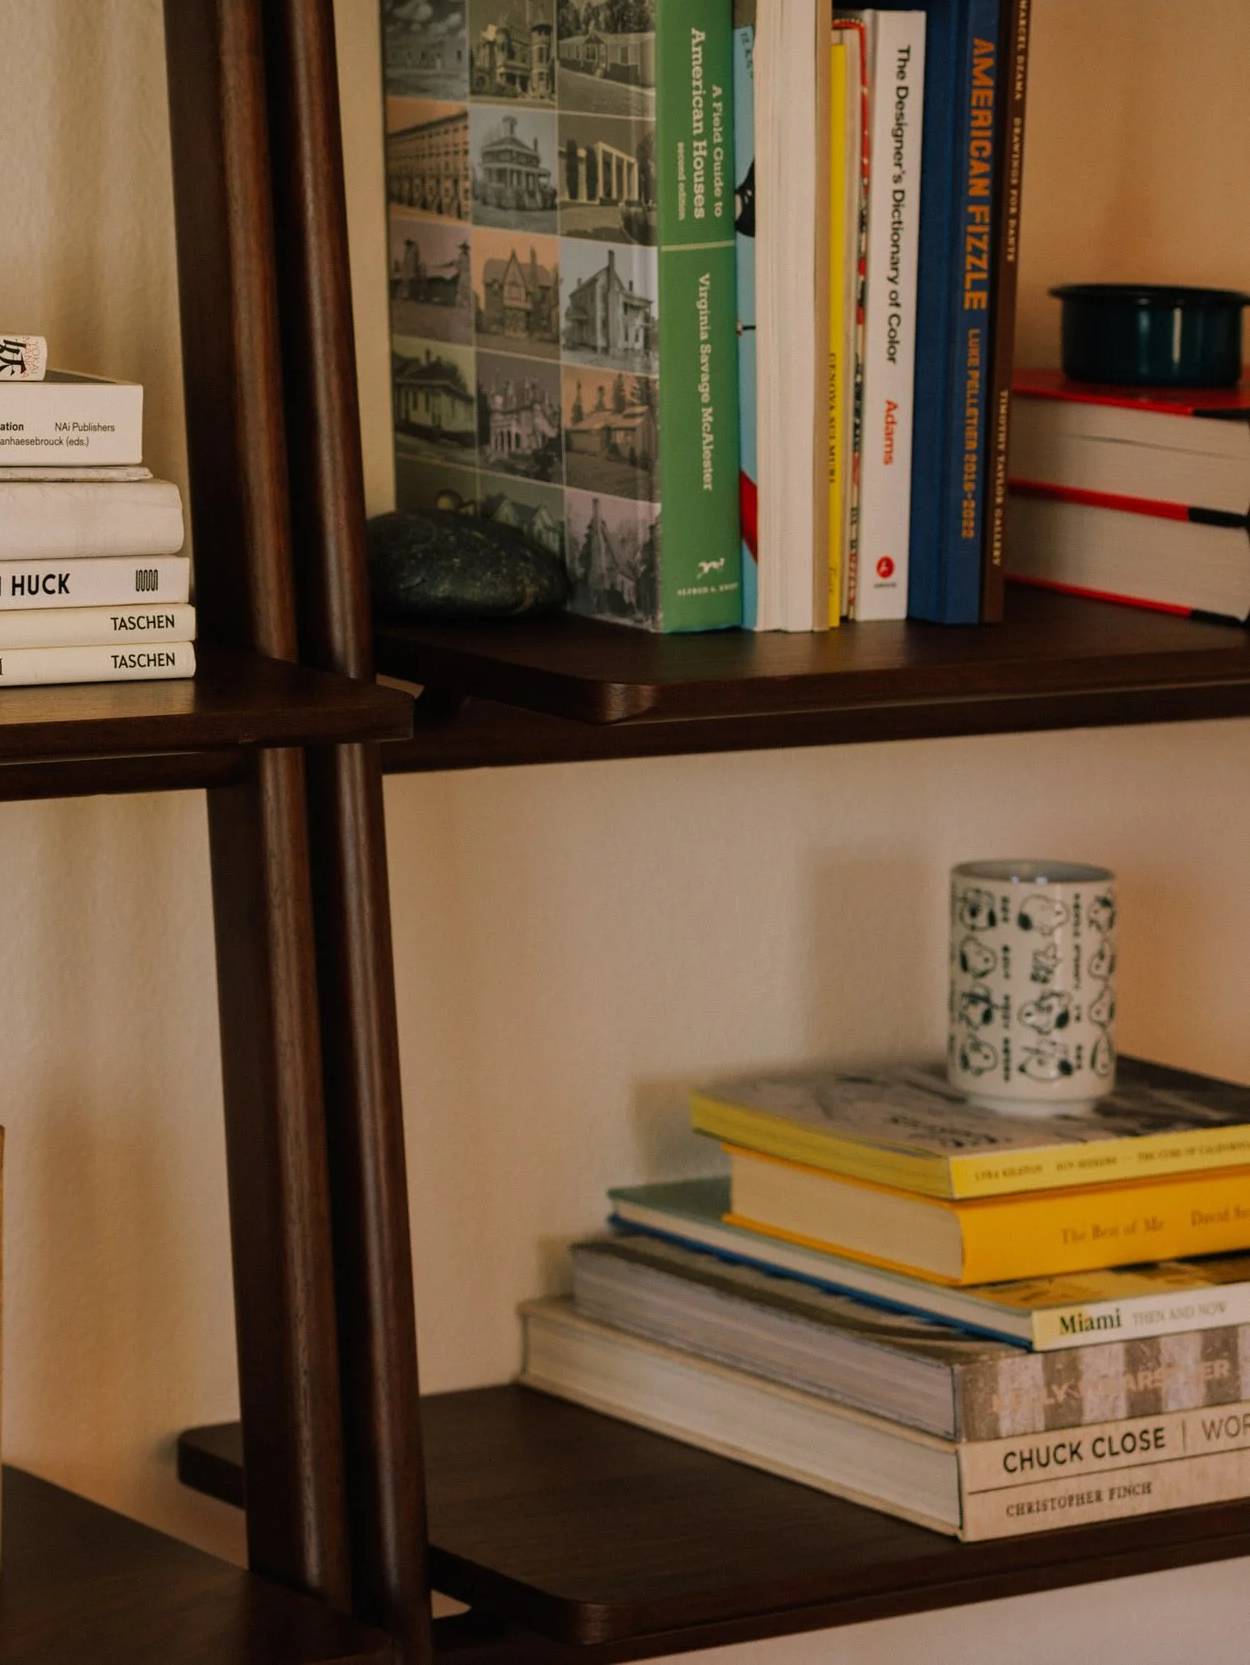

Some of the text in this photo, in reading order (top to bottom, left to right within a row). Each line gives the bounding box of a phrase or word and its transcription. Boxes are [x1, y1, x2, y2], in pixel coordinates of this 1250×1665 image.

[1016, 0, 1028, 50] MARCEL
[1014, 55, 1025, 100] DZAMA
[691, 28, 708, 219] American Houses
[712, 85, 724, 218] A Field Guide to
[1010, 118, 1022, 184] DRAWINGS
[963, 38, 995, 310] AMERICAN FIZZLE
[1008, 189, 1019, 214] FOR
[883, 44, 911, 466] The Designer's Dictionary of Color Adams
[967, 329, 981, 368] LUKE
[696, 273, 713, 491] Virginia Savage McAlester
[55, 422, 70, 431] NAi
[72, 422, 115, 432] Publishers
[66, 436, 90, 447] (eds.)
[993, 390, 1009, 566] TIMOTHY TAYLOR GALLERY
[11, 573, 71, 596] HUCK
[111, 614, 176, 631] TASCHEN
[111, 652, 176, 669] TASCHEN
[1061, 1228, 1087, 1245] The
[1091, 1224, 1120, 1240] Best
[1123, 1221, 1138, 1236] of
[1190, 1207, 1230, 1227] David
[1059, 1300, 1229, 1336] Miami THEN AND NOW
[1003, 1427, 1166, 1473] CHUCK CLOSE
[1006, 1481, 1153, 1518] CHRISTOPHER FINCH
